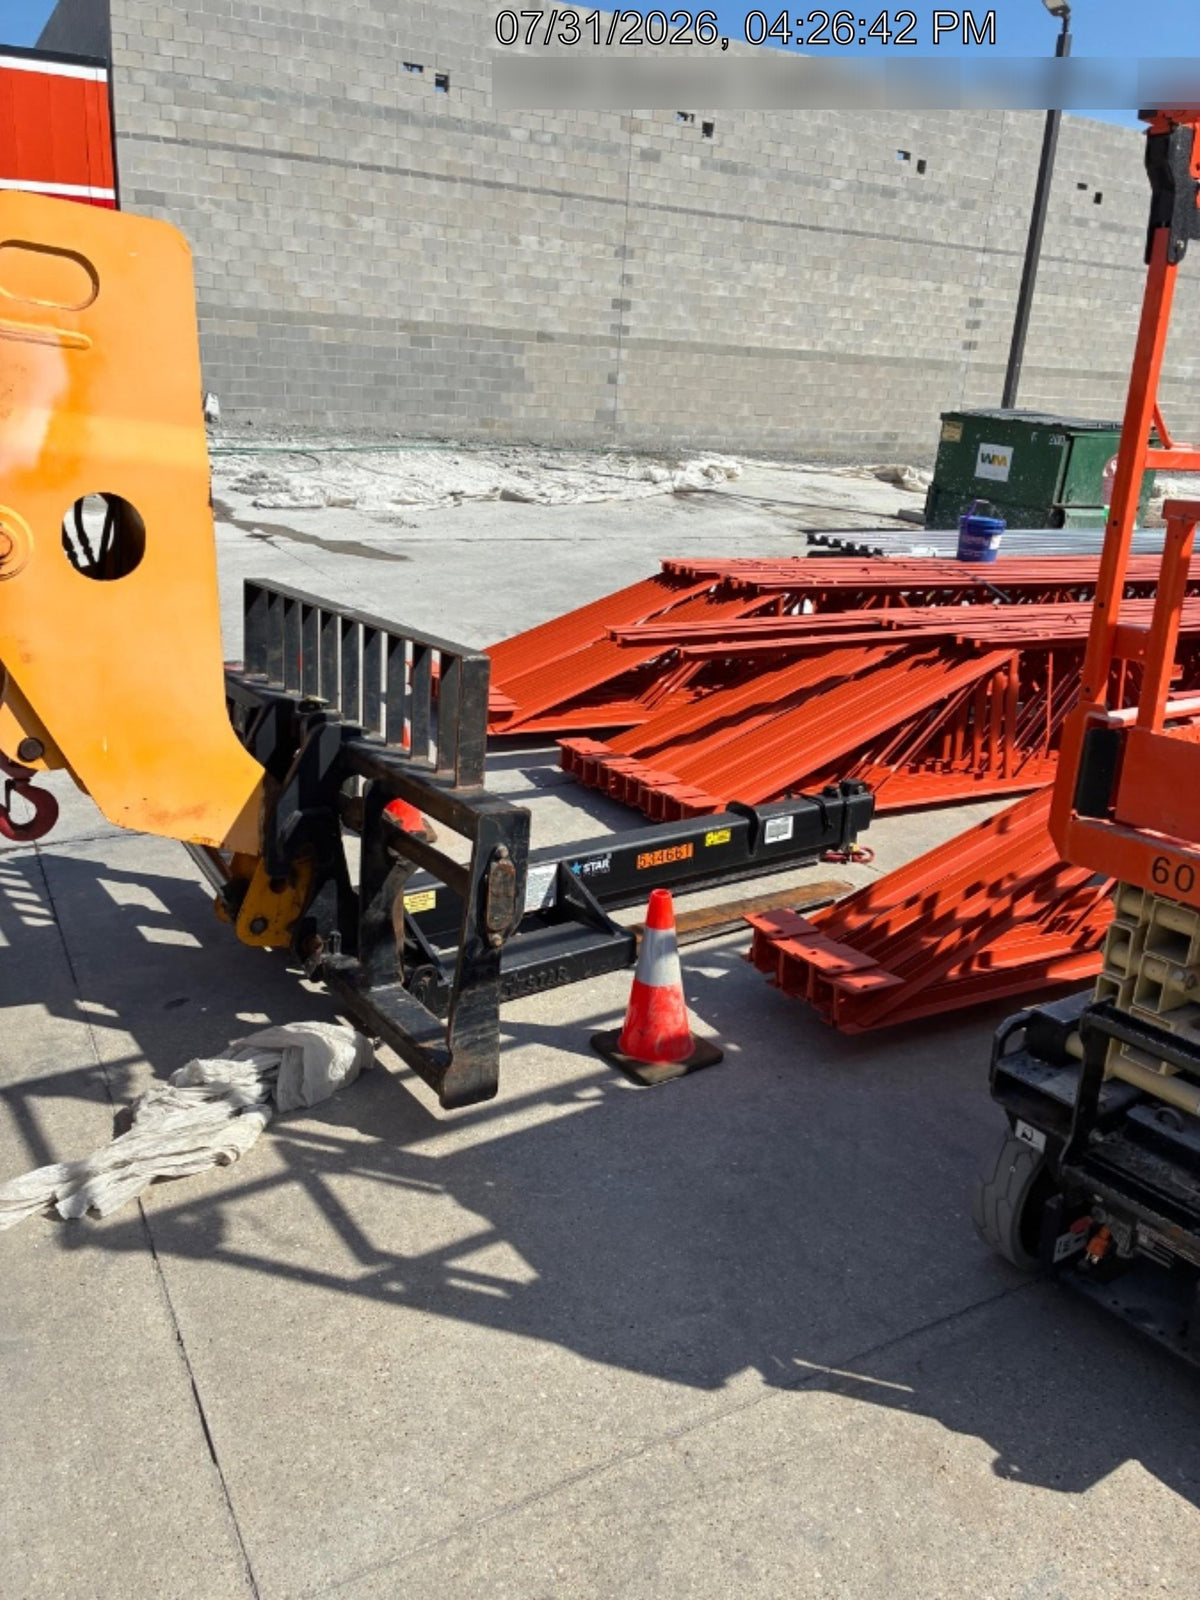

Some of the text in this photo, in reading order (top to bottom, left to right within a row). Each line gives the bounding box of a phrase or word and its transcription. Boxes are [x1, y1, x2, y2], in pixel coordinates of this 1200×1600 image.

[981, 453, 1007, 466] WM
[582, 858, 610, 873] STAR
[1152, 856, 1195, 893] 60
